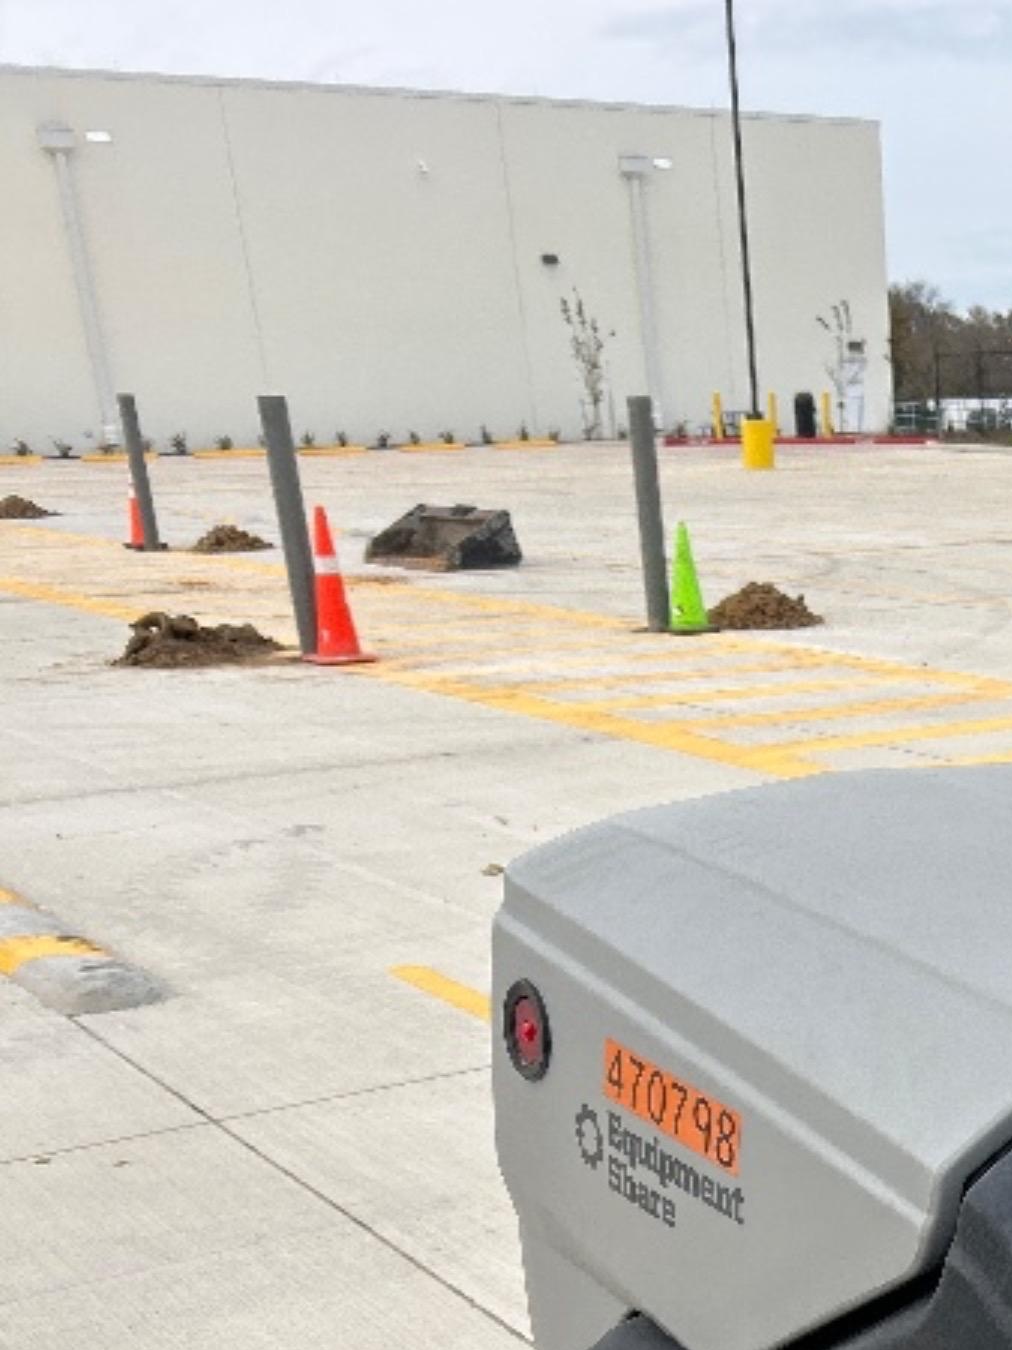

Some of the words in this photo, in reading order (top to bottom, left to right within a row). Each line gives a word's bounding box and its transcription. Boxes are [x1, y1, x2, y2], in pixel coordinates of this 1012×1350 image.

[607, 1049, 736, 1168] 470798
[607, 1109, 744, 1225] Equipment
[608, 1154, 675, 1228] Share
